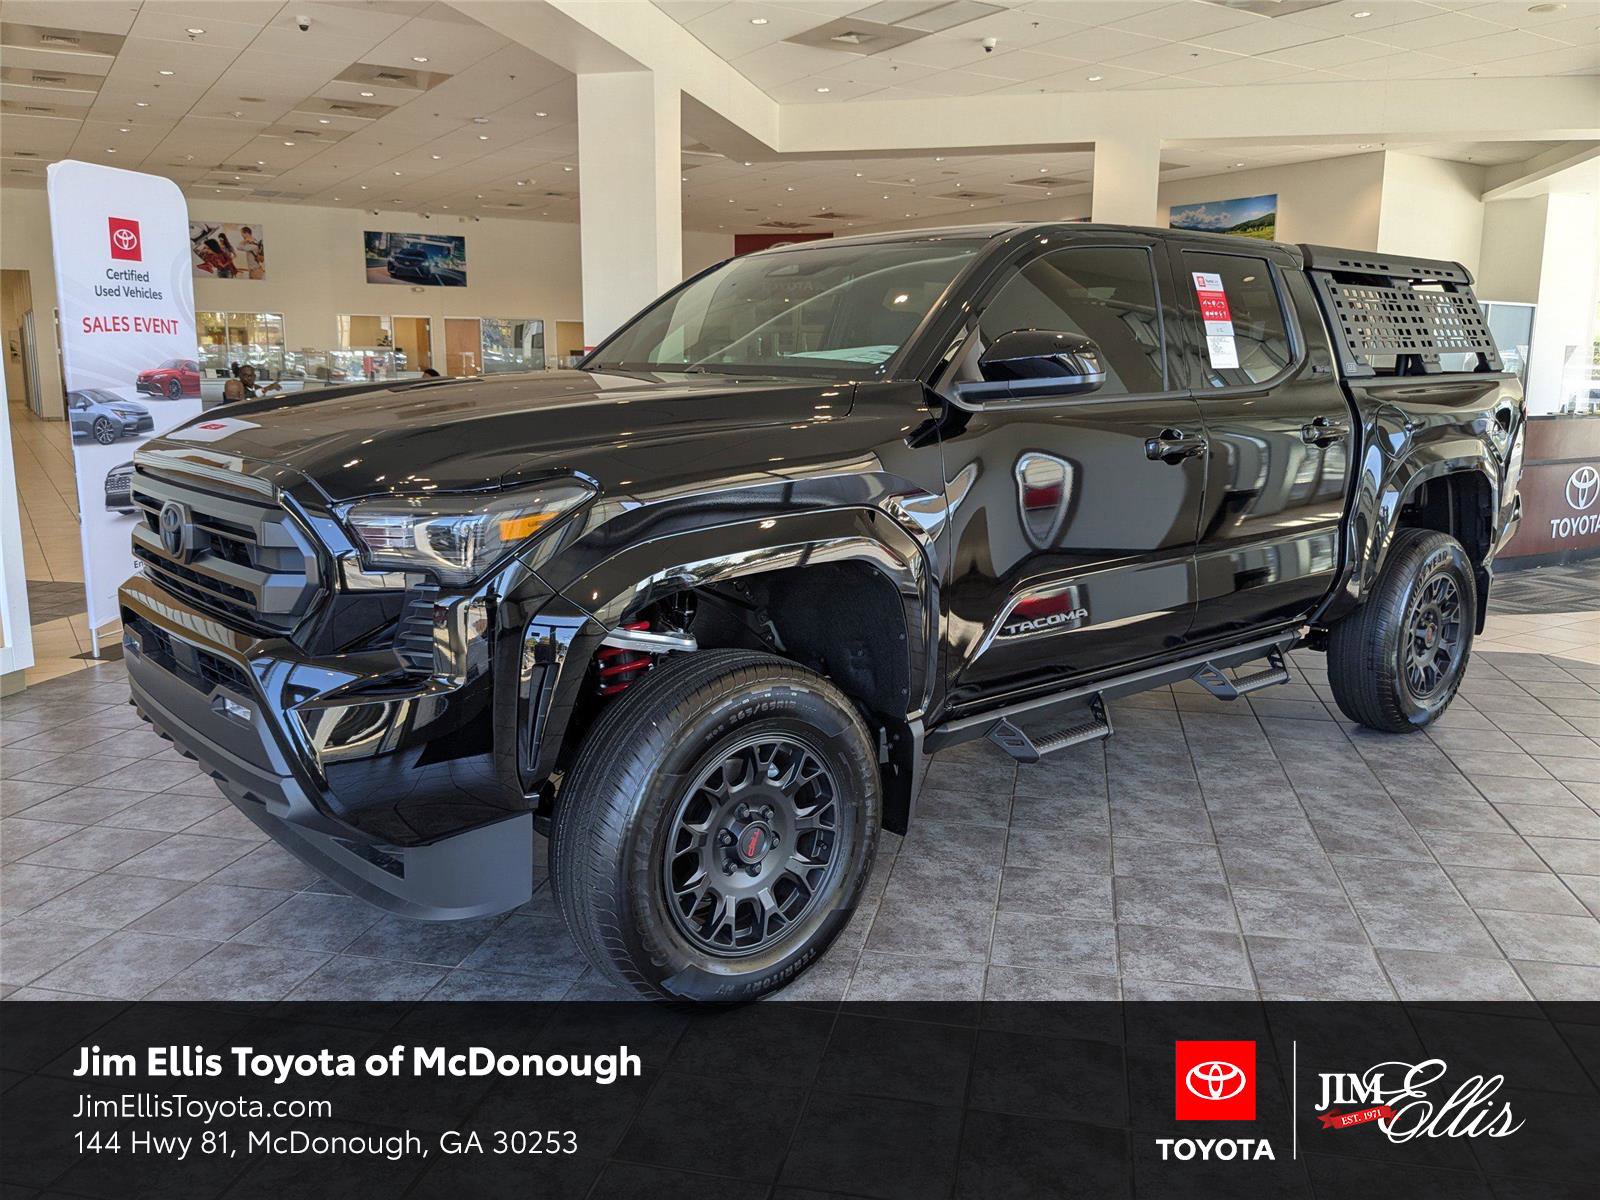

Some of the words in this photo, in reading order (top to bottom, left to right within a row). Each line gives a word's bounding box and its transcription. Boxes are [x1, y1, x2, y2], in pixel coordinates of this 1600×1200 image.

[105, 268, 150, 283] Certified
[95, 285, 121, 297] Used
[122, 286, 163, 300] Vehicles
[82, 316, 130, 334] SALES
[133, 316, 179, 336] EVENT
[133, 560, 144, 569] En
[1003, 608, 1089, 634] TACOMA
